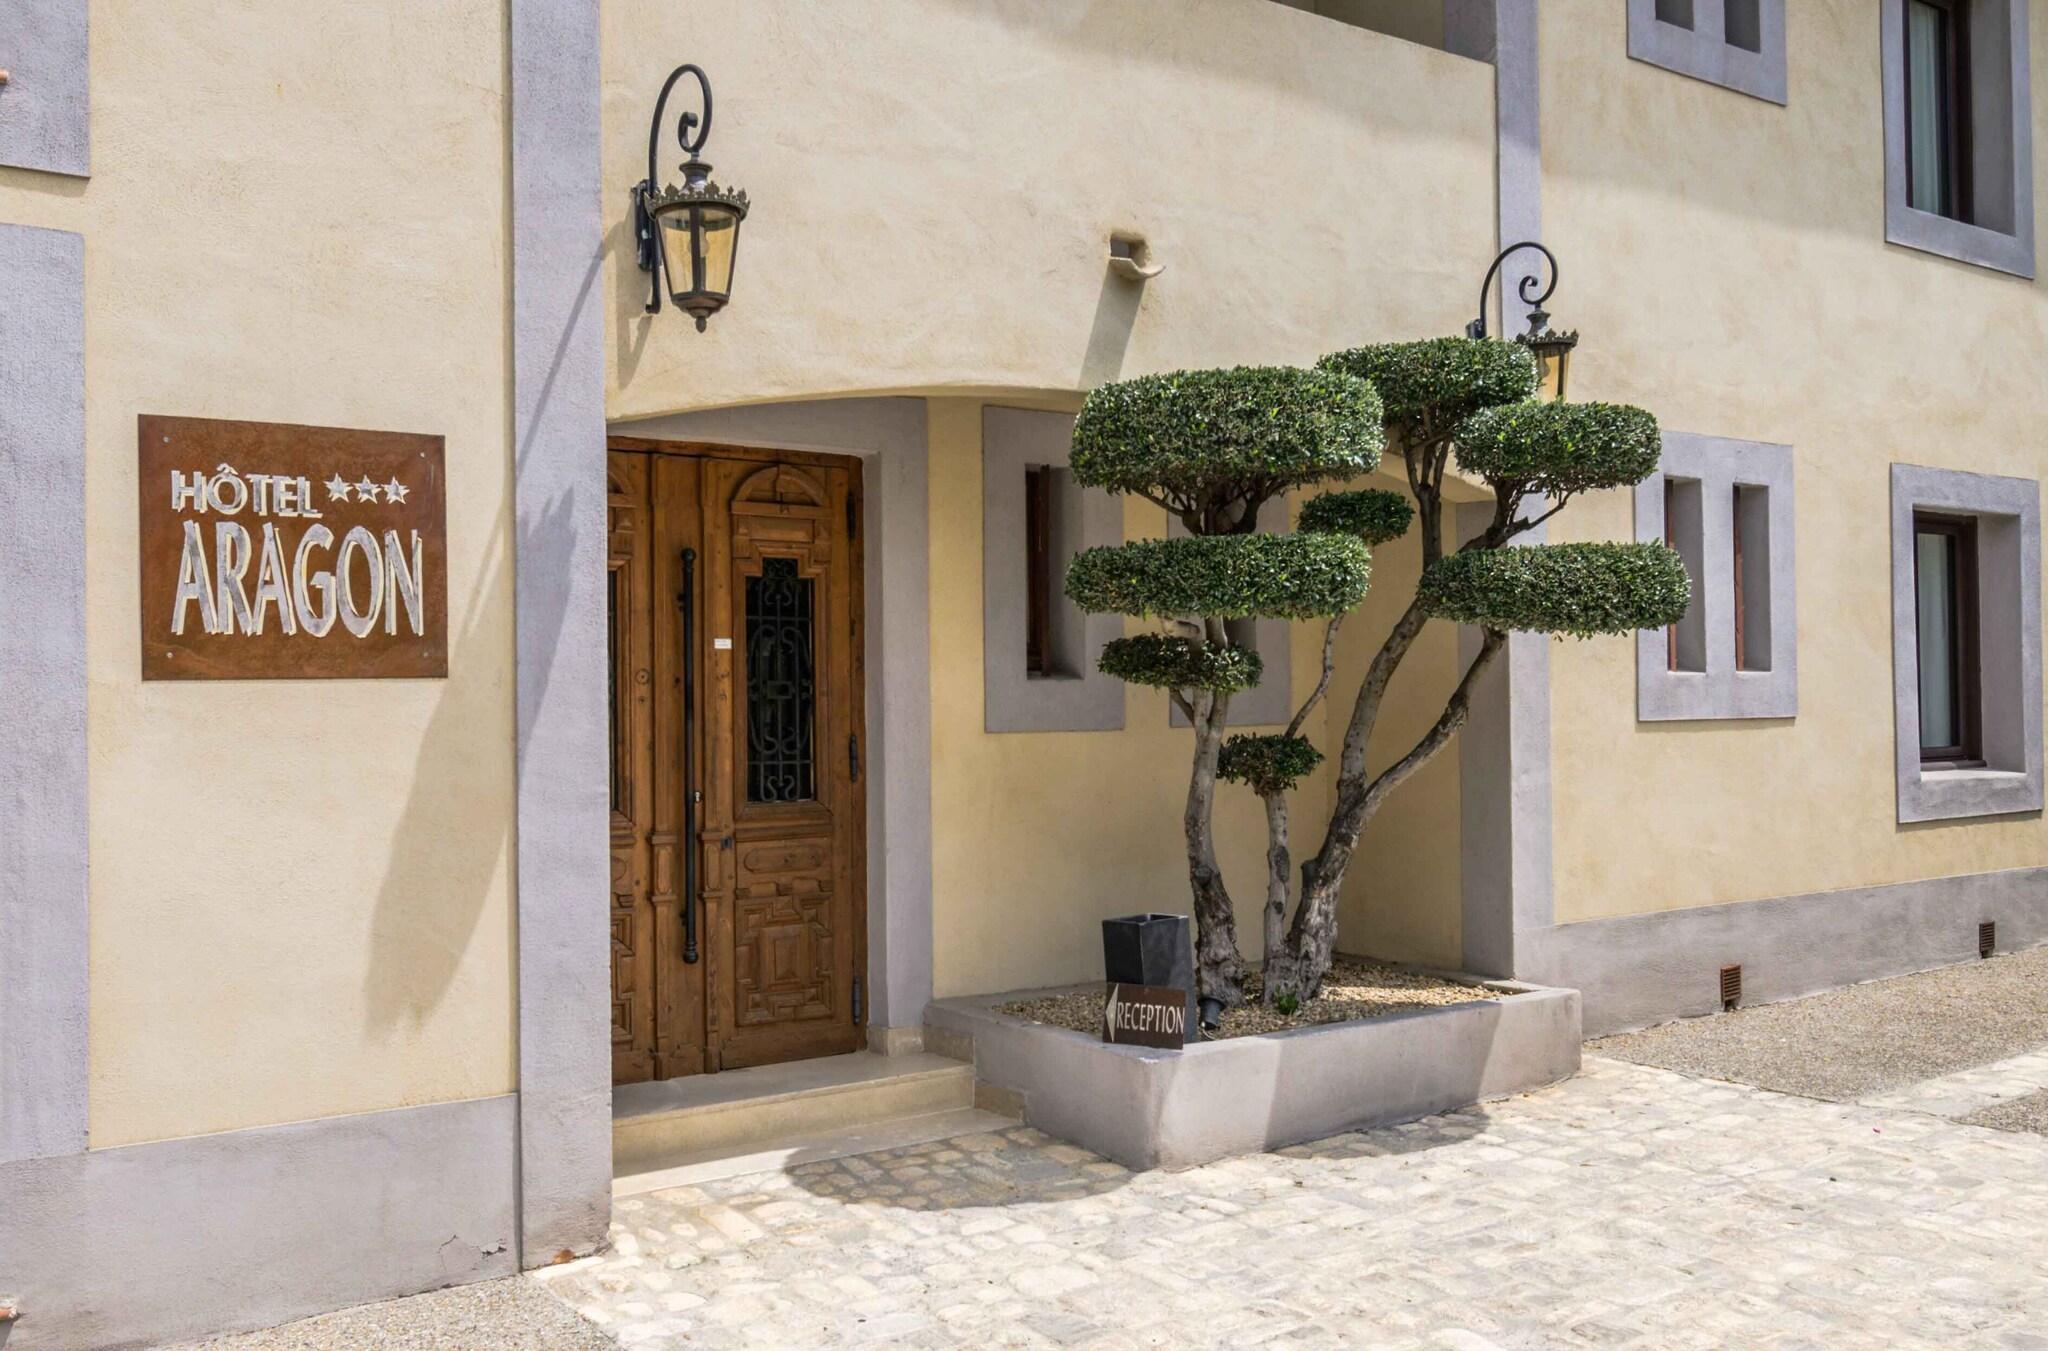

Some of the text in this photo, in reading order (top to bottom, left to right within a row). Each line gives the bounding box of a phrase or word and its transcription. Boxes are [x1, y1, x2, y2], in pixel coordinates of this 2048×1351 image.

[171, 463, 323, 518] HÔTEL
[171, 519, 424, 638] ARAGON
[1116, 1002, 1185, 1034] RECEPTION
